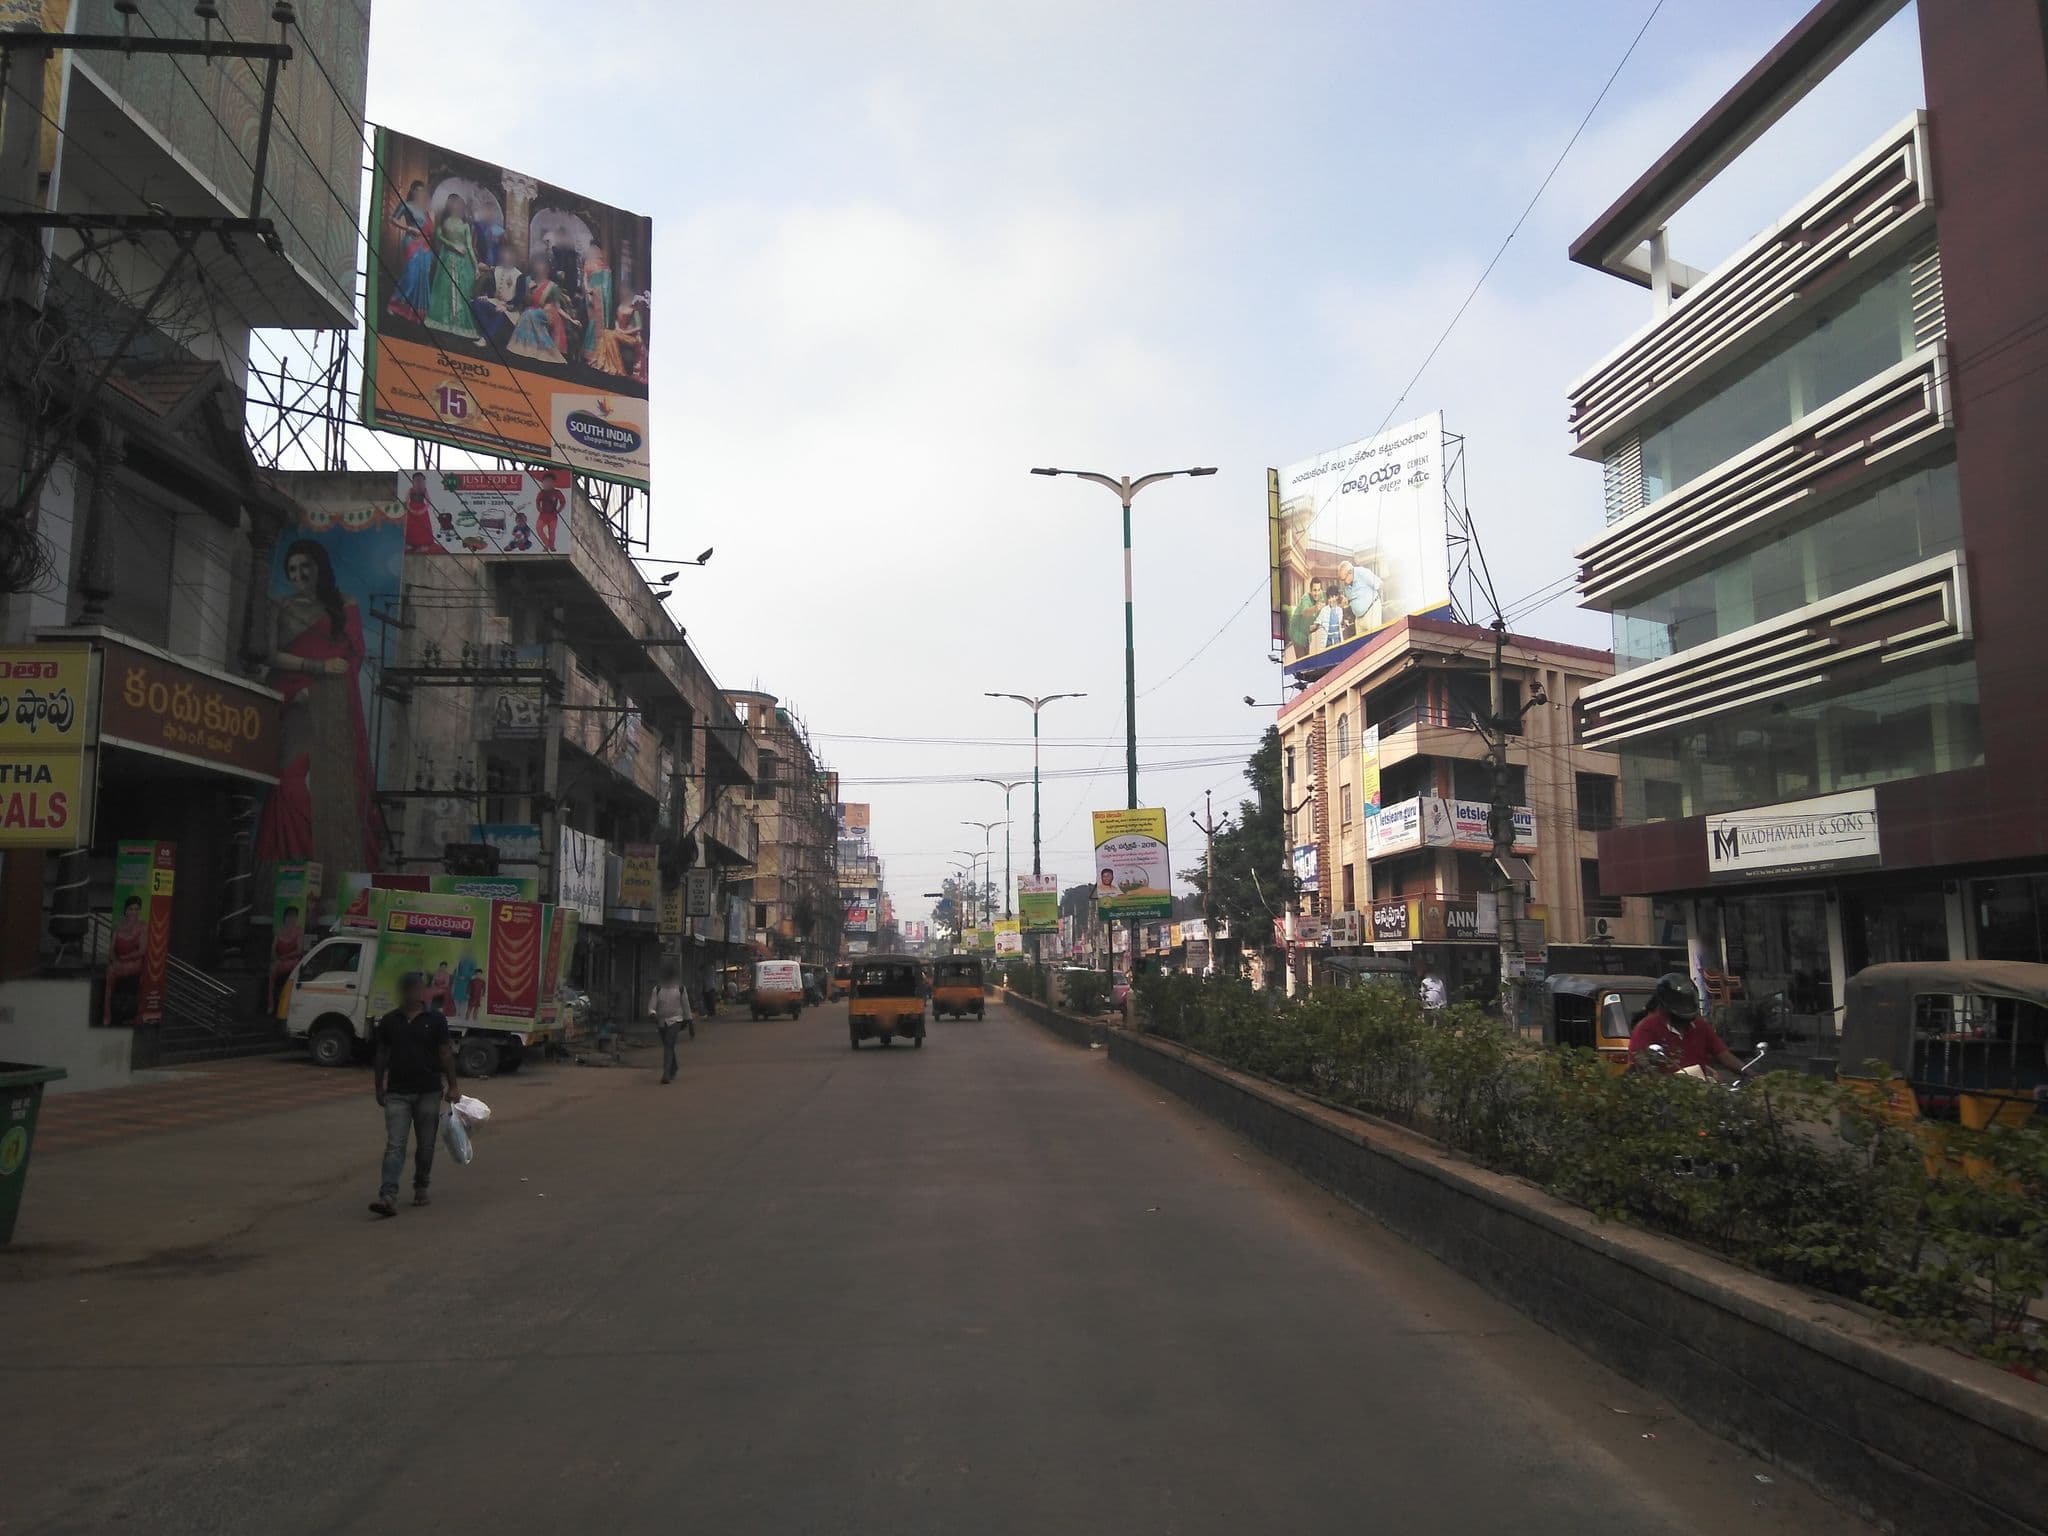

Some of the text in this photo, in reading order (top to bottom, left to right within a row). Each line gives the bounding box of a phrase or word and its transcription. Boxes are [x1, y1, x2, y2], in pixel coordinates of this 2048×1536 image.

[436, 386, 468, 419] 15
[570, 420, 604, 438] SOUTH
[606, 427, 634, 445] INDIA
[583, 434, 613, 448] shopping
[1406, 455, 1430, 470] CEMENT
[510, 475, 518, 484] U
[16, 687, 75, 734] షాపు
[123, 667, 261, 741] కందుకూరి
[0, 764, 53, 784] THA
[0, 791, 67, 829] ALS
[1456, 805, 1531, 825] letsle uru
[1741, 822, 1815, 846] MADHAVAIAH
[1818, 820, 1828, 836] &
[1831, 814, 1864, 834] SONS
[499, 904, 514, 922] 5
